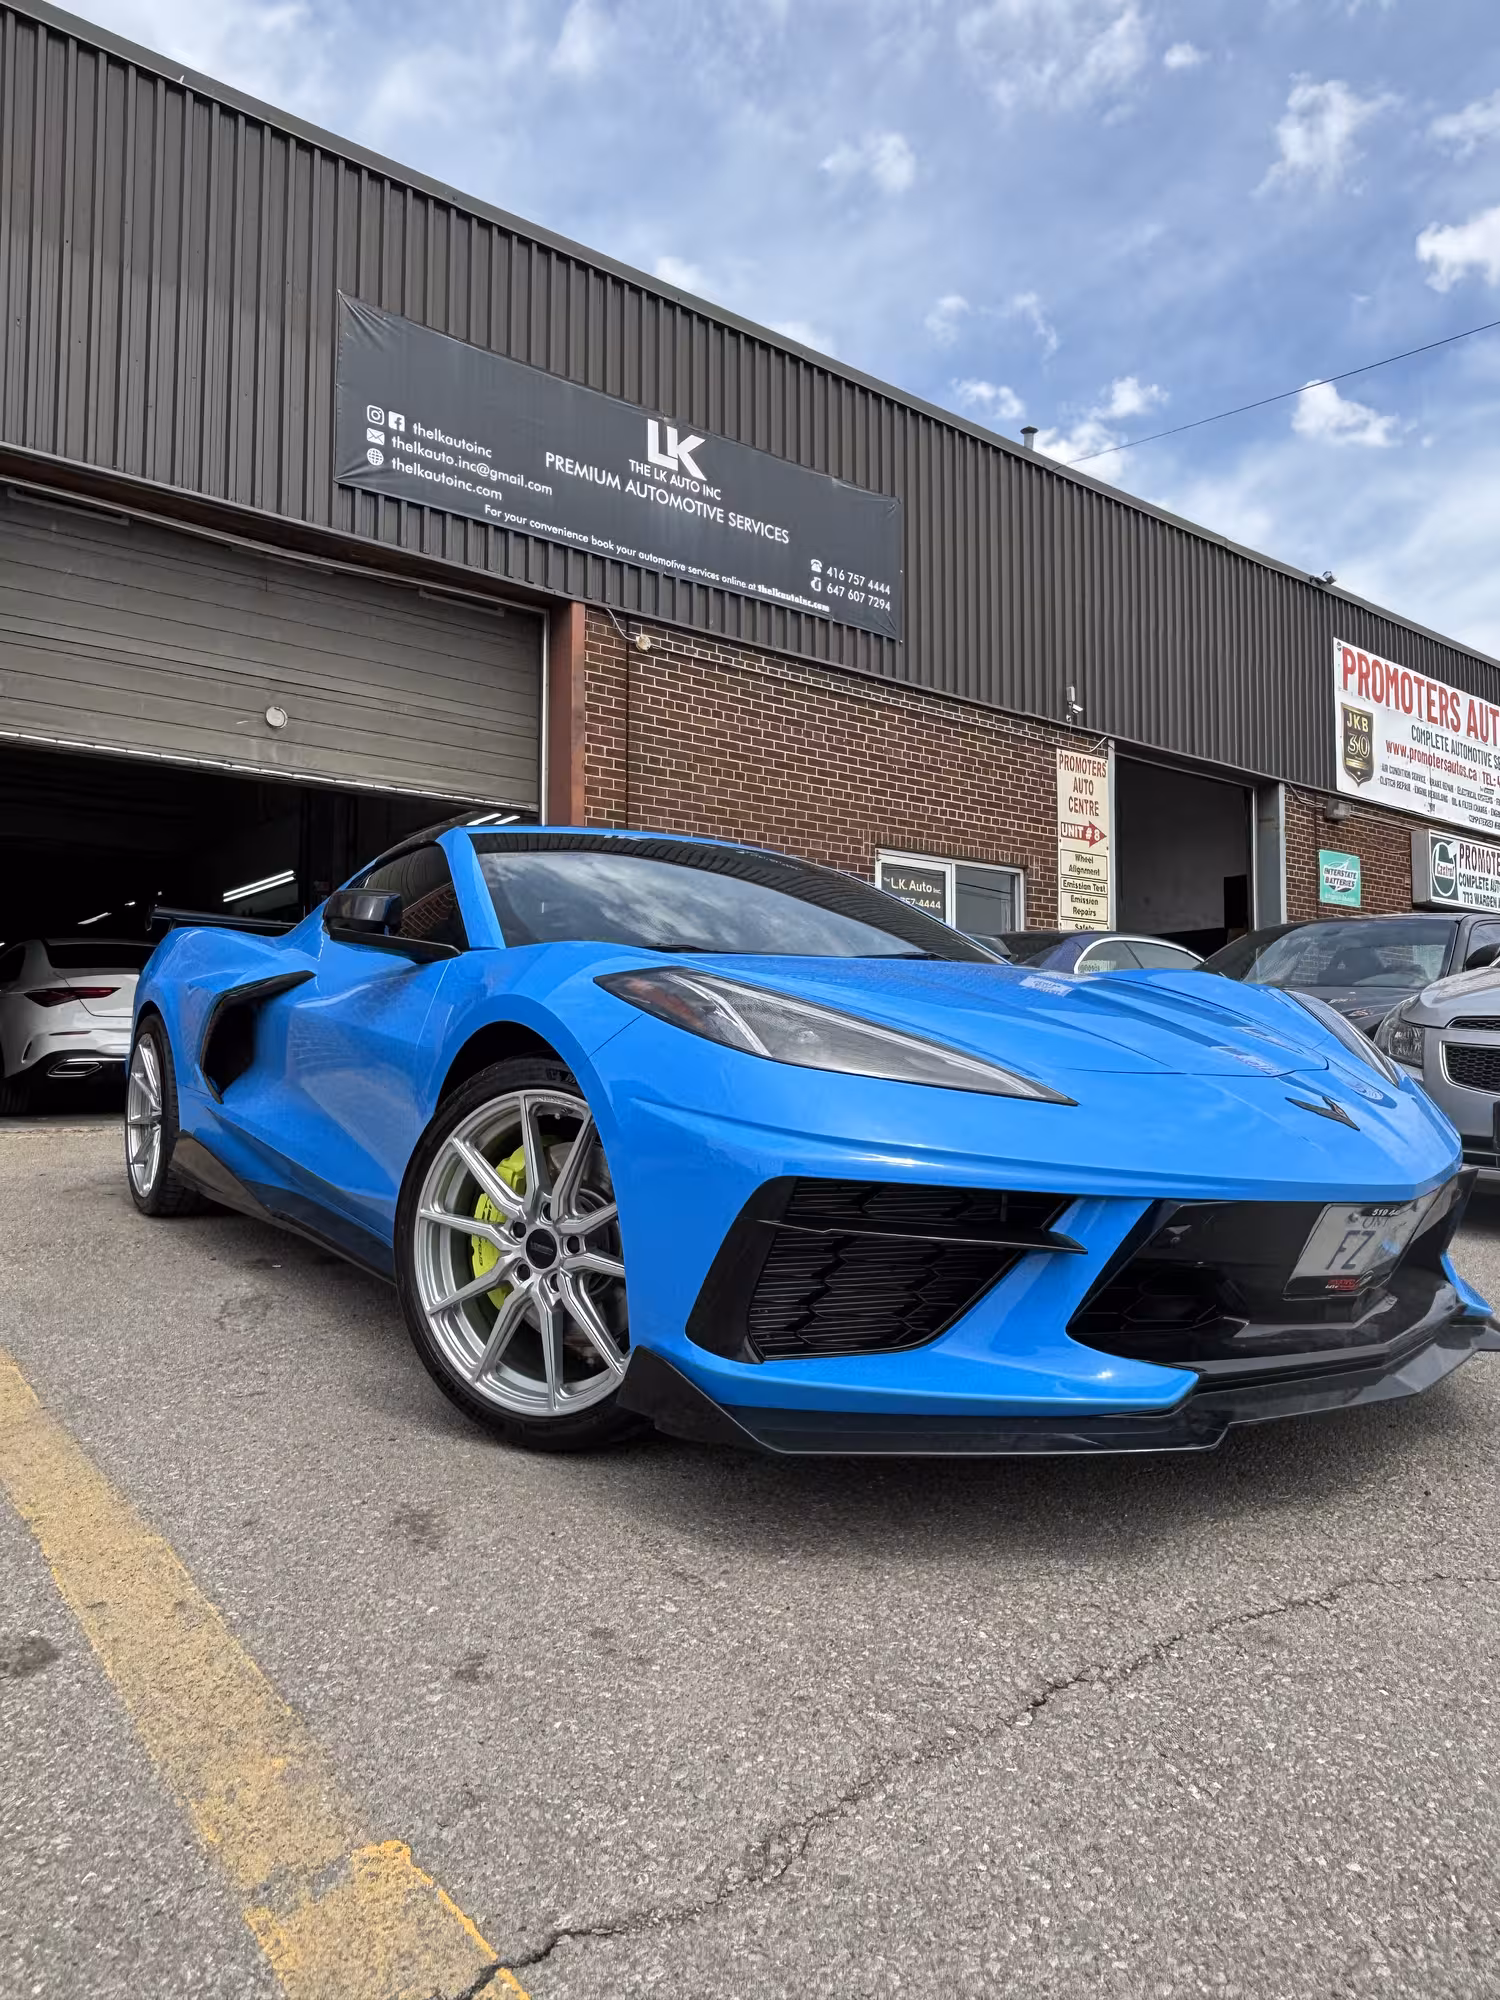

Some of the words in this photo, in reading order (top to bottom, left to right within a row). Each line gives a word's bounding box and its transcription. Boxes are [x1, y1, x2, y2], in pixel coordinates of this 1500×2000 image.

[412, 422, 492, 458] thelkautoinc
[647, 418, 707, 481] LK
[391, 436, 553, 495] thelkauto.inc@gmail.com
[391, 458, 503, 500] thelkautoinc.com
[628, 459, 651, 477] THE
[653, 467, 668, 483] LK
[669, 473, 700, 493] AUTO
[702, 484, 721, 500] INC
[545, 451, 621, 491] PREMIUM
[624, 479, 724, 523] AUTOMOTIVE
[728, 511, 789, 544] SERVICES
[484, 504, 502, 518] For
[504, 512, 527, 525] your
[529, 519, 589, 543] convenience
[591, 535, 614, 550] book
[616, 543, 637, 557] your
[638, 551, 686, 572] automotive
[687, 564, 720, 581] services
[747, 582, 757, 591] at
[757, 584, 830, 613] thelkautoinc.com
[826, 566, 845, 581] 416
[847, 572, 865, 587] 757
[867, 578, 891, 595] 4444
[826, 583, 845, 597] 647
[847, 589, 865, 603] 607
[868, 595, 891, 611] 7294
[1342, 646, 1461, 733] PROMOTERS
[1346, 711, 1369, 732] JKB
[1347, 732, 1370, 759] 30
[1411, 724, 1449, 753] COMPLETE
[1450, 739, 1493, 768] AUTOMOTIVE
[1059, 751, 1107, 778] PROMOTERS
[1385, 740, 1477, 781] www.promotersautos.ca
[1072, 777, 1094, 796] AUTO
[1068, 796, 1100, 817] CENTRE
[1061, 823, 1084, 838] UNIT
[1085, 827, 1092, 840] #
[1093, 829, 1100, 841] 8
[1068, 864, 1100, 877] Alignment
[1074, 853, 1094, 864] Wheel
[908, 880, 933, 893] Auto
[1062, 879, 1092, 891] Emission
[1092, 883, 1106, 893] Test
[1324, 867, 1357, 880] INTERSTATE
[1325, 876, 1355, 888] BATTERIES
[1459, 872, 1489, 892] COMPLETE
[1070, 895, 1099, 906] Emission
[1072, 907, 1097, 917] Repairs
